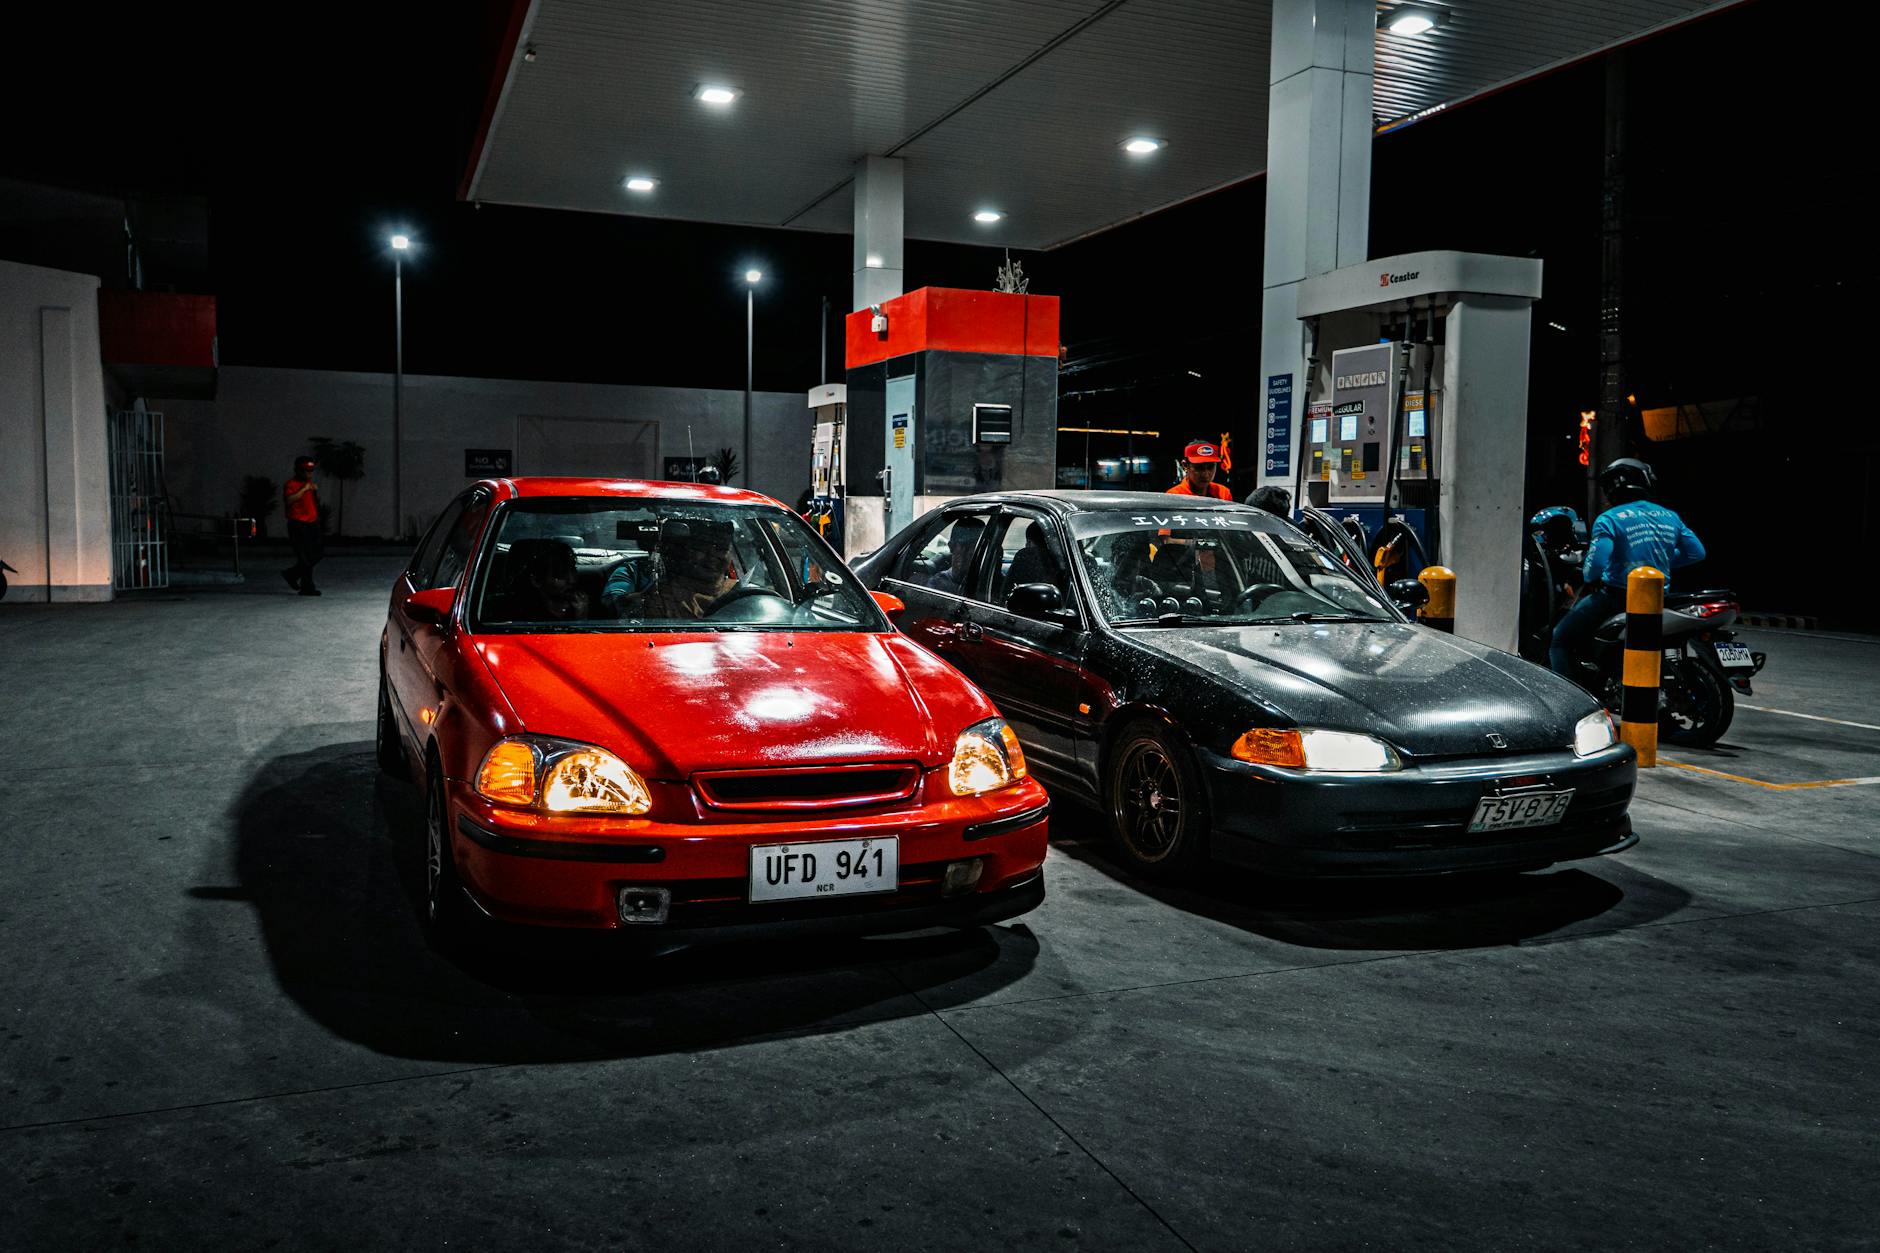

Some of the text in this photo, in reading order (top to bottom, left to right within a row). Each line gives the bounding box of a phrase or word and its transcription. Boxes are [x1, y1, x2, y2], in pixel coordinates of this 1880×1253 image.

[1390, 272, 1420, 283] Censtar
[1272, 379, 1288, 387] SAFETY
[1268, 386, 1292, 395] GUIDELINES
[1405, 399, 1424, 407] DIESE
[766, 848, 883, 885] UFD 941
[816, 883, 835, 892] NCR
